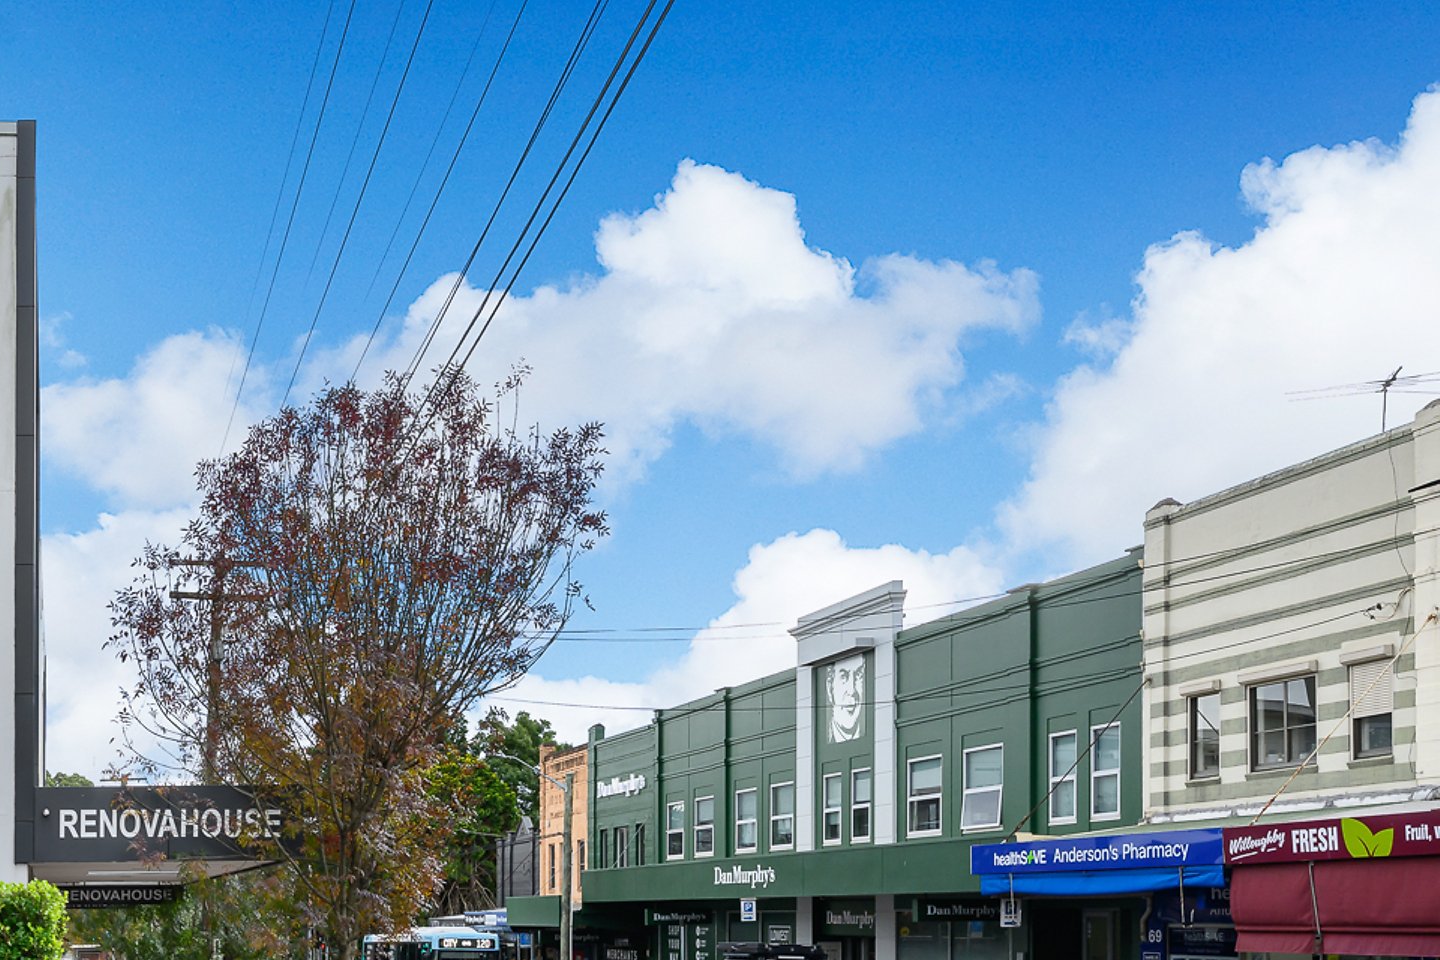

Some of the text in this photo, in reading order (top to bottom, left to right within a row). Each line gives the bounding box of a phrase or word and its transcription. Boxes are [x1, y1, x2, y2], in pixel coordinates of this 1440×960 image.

[59, 808, 281, 839] RENOVAHOUSE
[1405, 823, 1432, 843] Fruit,
[1229, 826, 1339, 855] Willoughby FRESH
[1053, 845, 1119, 864] Anderson's
[1122, 842, 1190, 862] Pharmacy
[68, 888, 173, 901] ENOVAHOUSE
[476, 938, 491, 948] 120
[1148, 929, 1162, 943] 69
